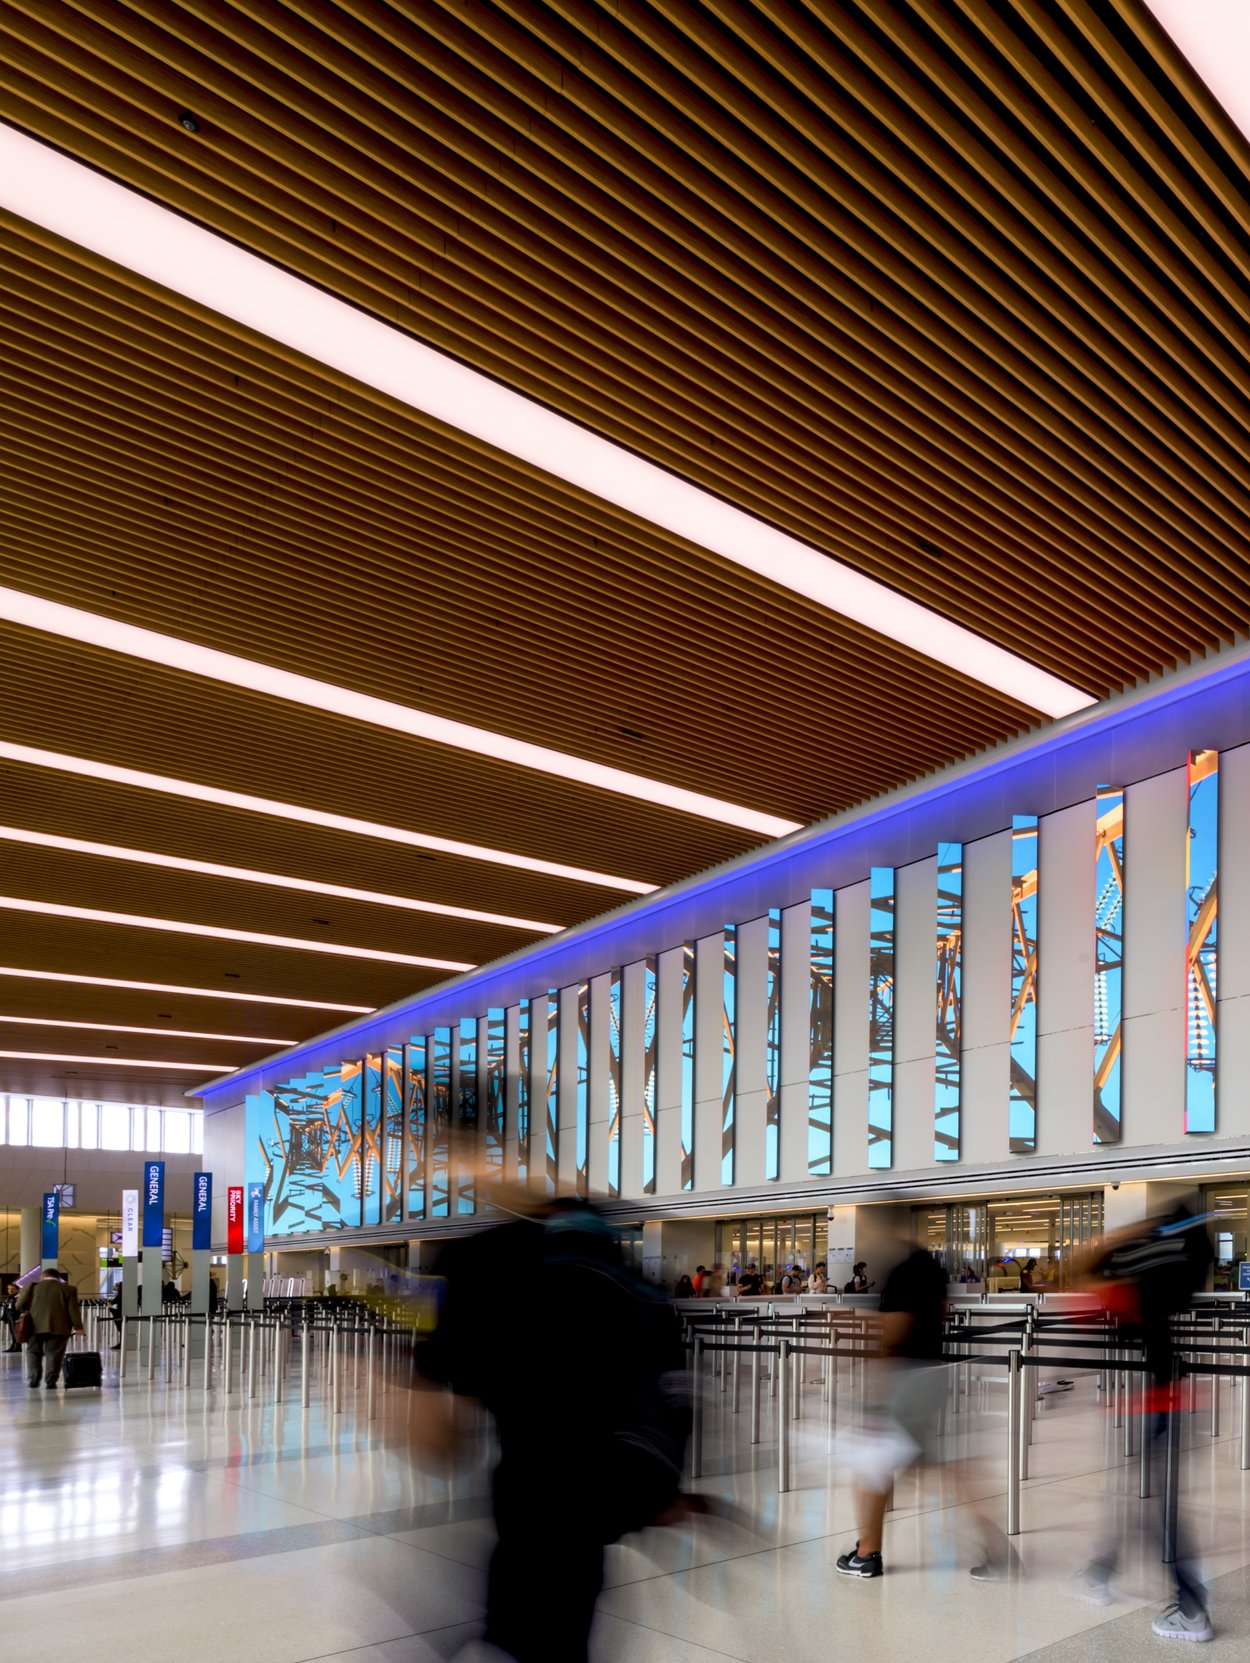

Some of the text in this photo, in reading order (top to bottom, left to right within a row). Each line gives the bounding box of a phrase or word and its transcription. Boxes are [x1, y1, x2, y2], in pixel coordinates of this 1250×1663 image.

[47, 1196, 55, 1208] TSA
[149, 1166, 159, 1205] GENERAL
[198, 1176, 207, 1212] GENERAL
